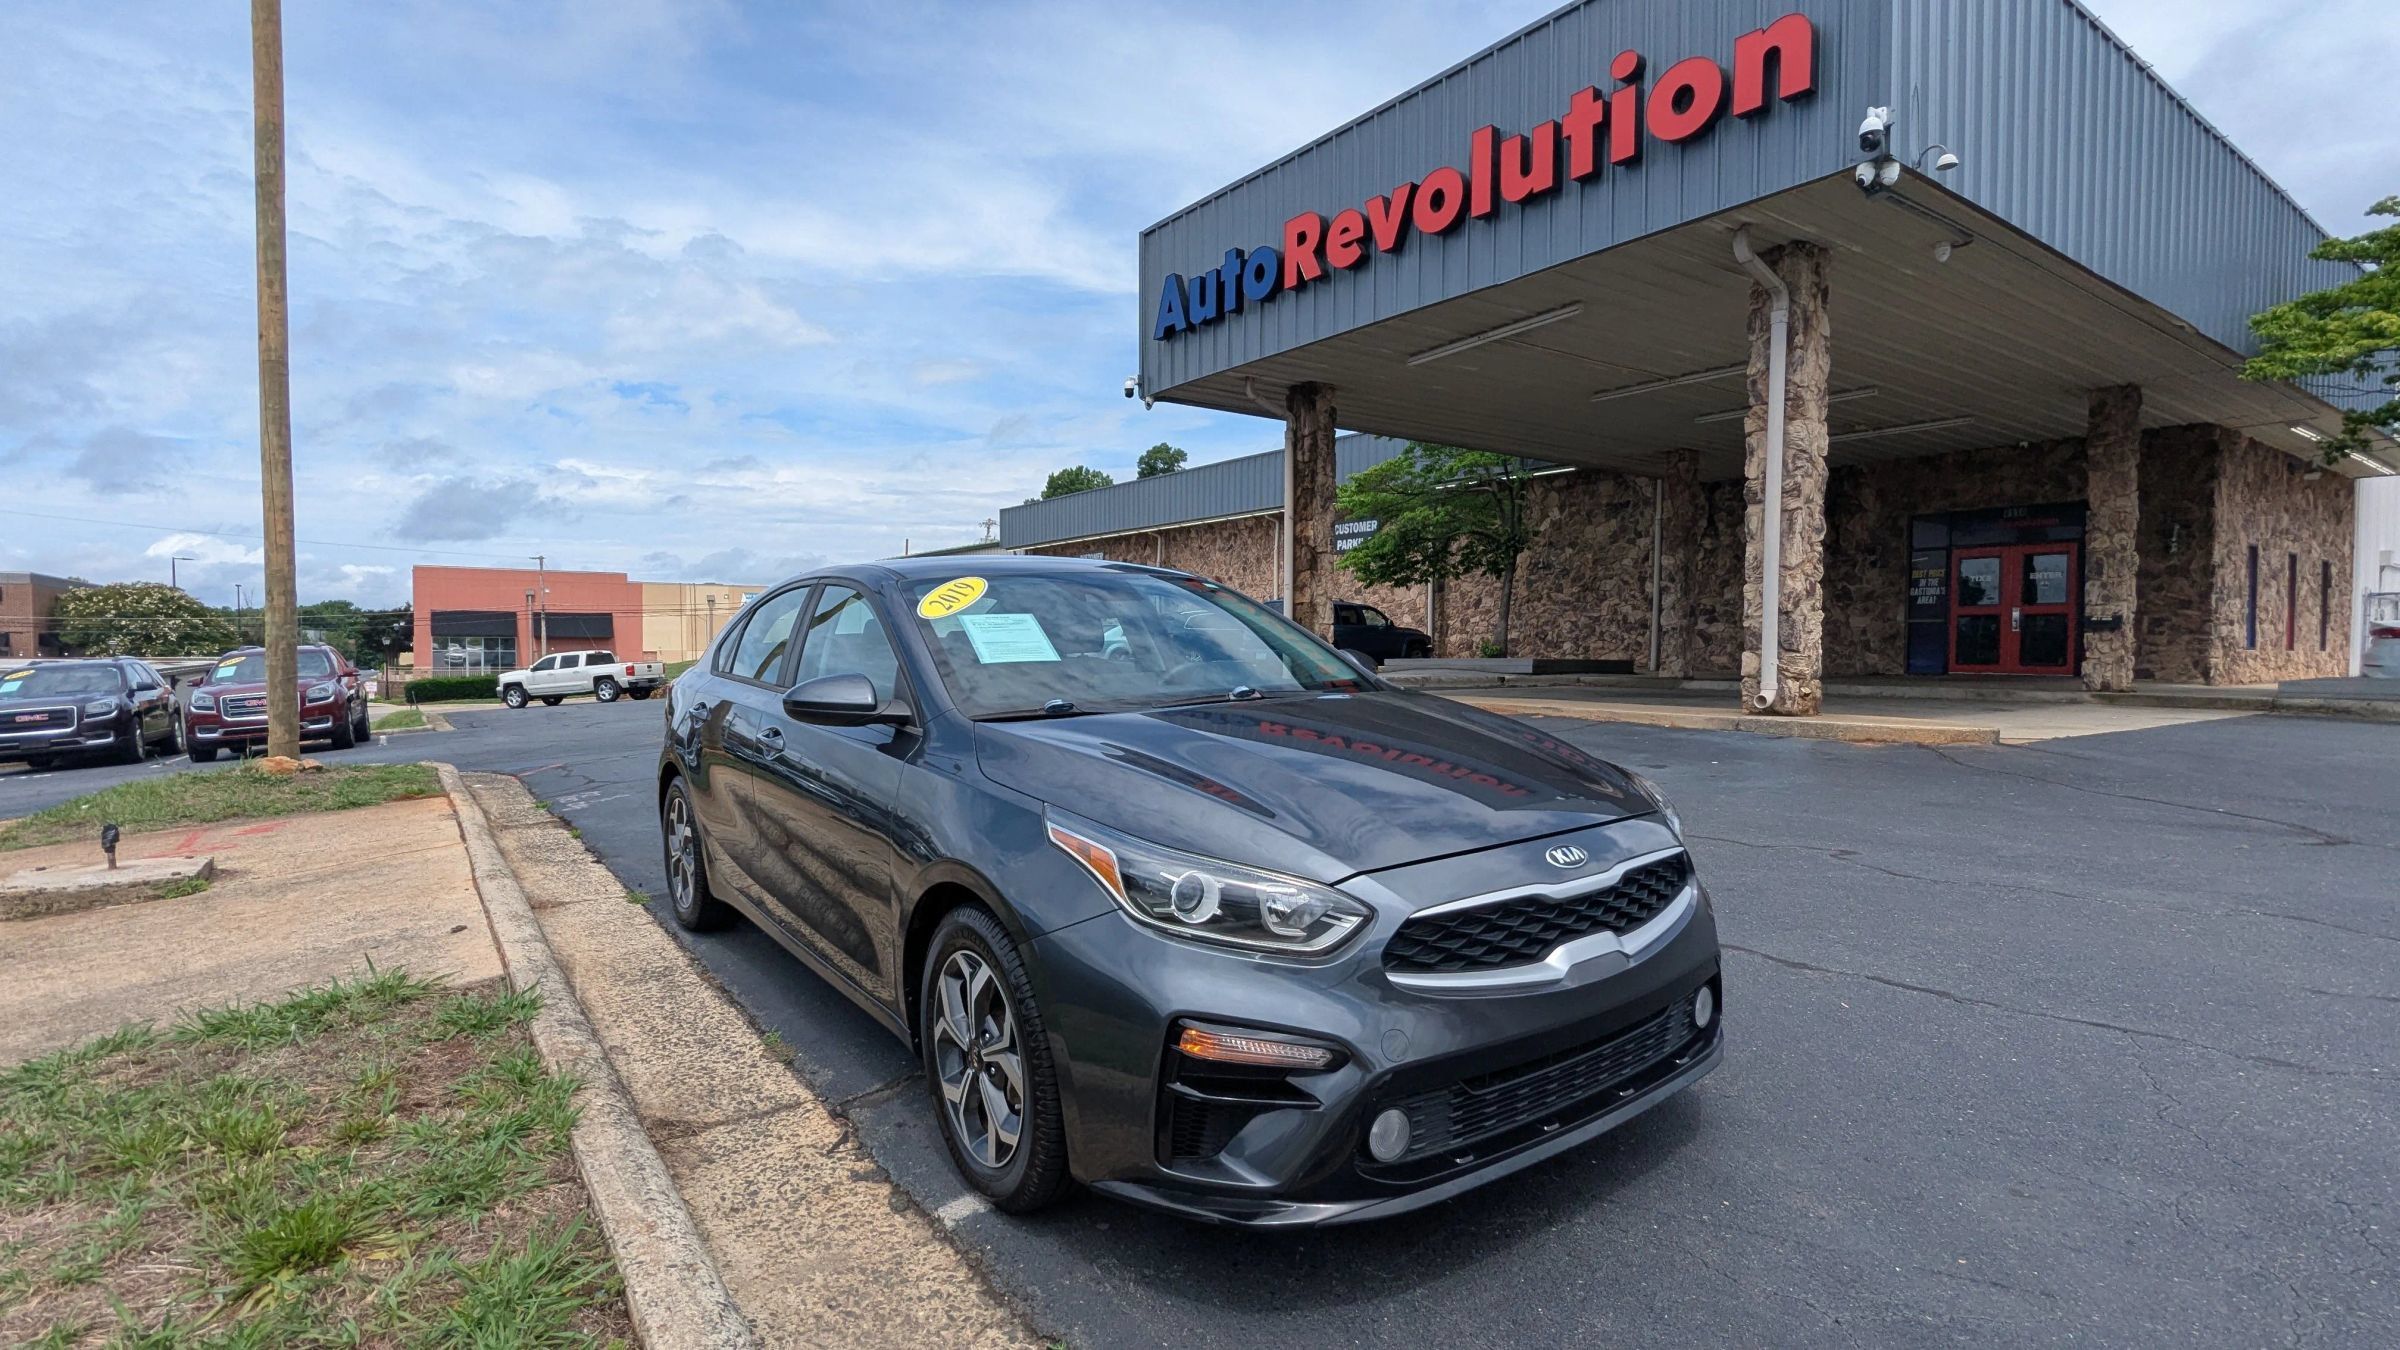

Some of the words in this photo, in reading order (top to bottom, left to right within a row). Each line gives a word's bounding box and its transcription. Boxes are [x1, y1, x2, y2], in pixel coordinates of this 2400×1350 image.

[1334, 520, 1378, 535] CUSTOMER
[1336, 537, 1372, 551] PARK
[929, 582, 975, 611] 2019
[244, 699, 267, 707] GM
[15, 713, 49, 723] GMC
[1550, 846, 1585, 864] KIA
